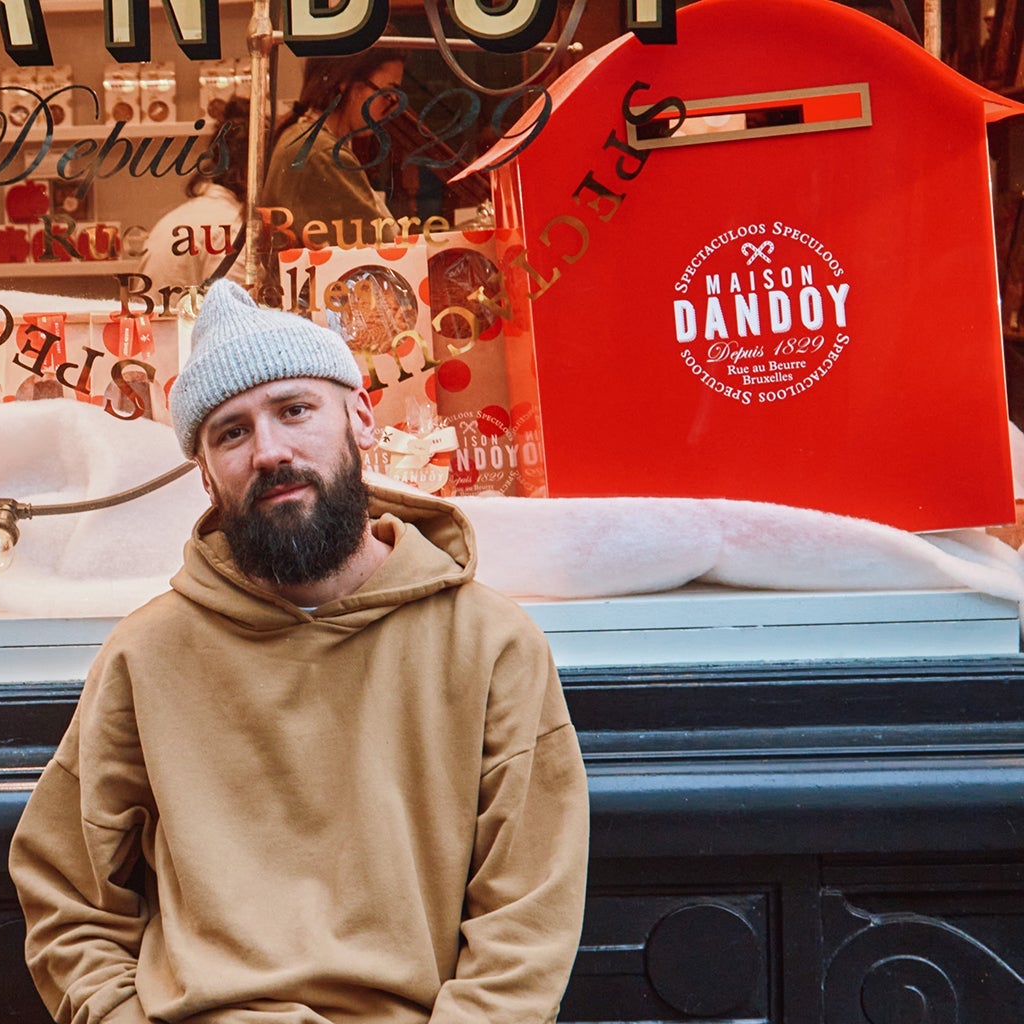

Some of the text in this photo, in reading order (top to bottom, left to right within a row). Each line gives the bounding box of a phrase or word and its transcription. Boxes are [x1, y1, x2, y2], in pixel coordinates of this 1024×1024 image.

[288, 85, 553, 172] 1829
[38, 206, 450, 261] Rue au Beurre
[674, 221, 844, 294] SPECTACULOOS SPECULOOS
[705, 265, 813, 295] MAISON
[673, 283, 850, 343] DANDOY
[706, 334, 825, 364] Depuis 1829
[680, 333, 850, 405] SPECTACULOOS SPECULOOS
[727, 360, 806, 375] Rue au Beurre
[742, 373, 793, 385] Bruxelles
[463, 434, 499, 448] ISON
[456, 442, 520, 472] NDOY
